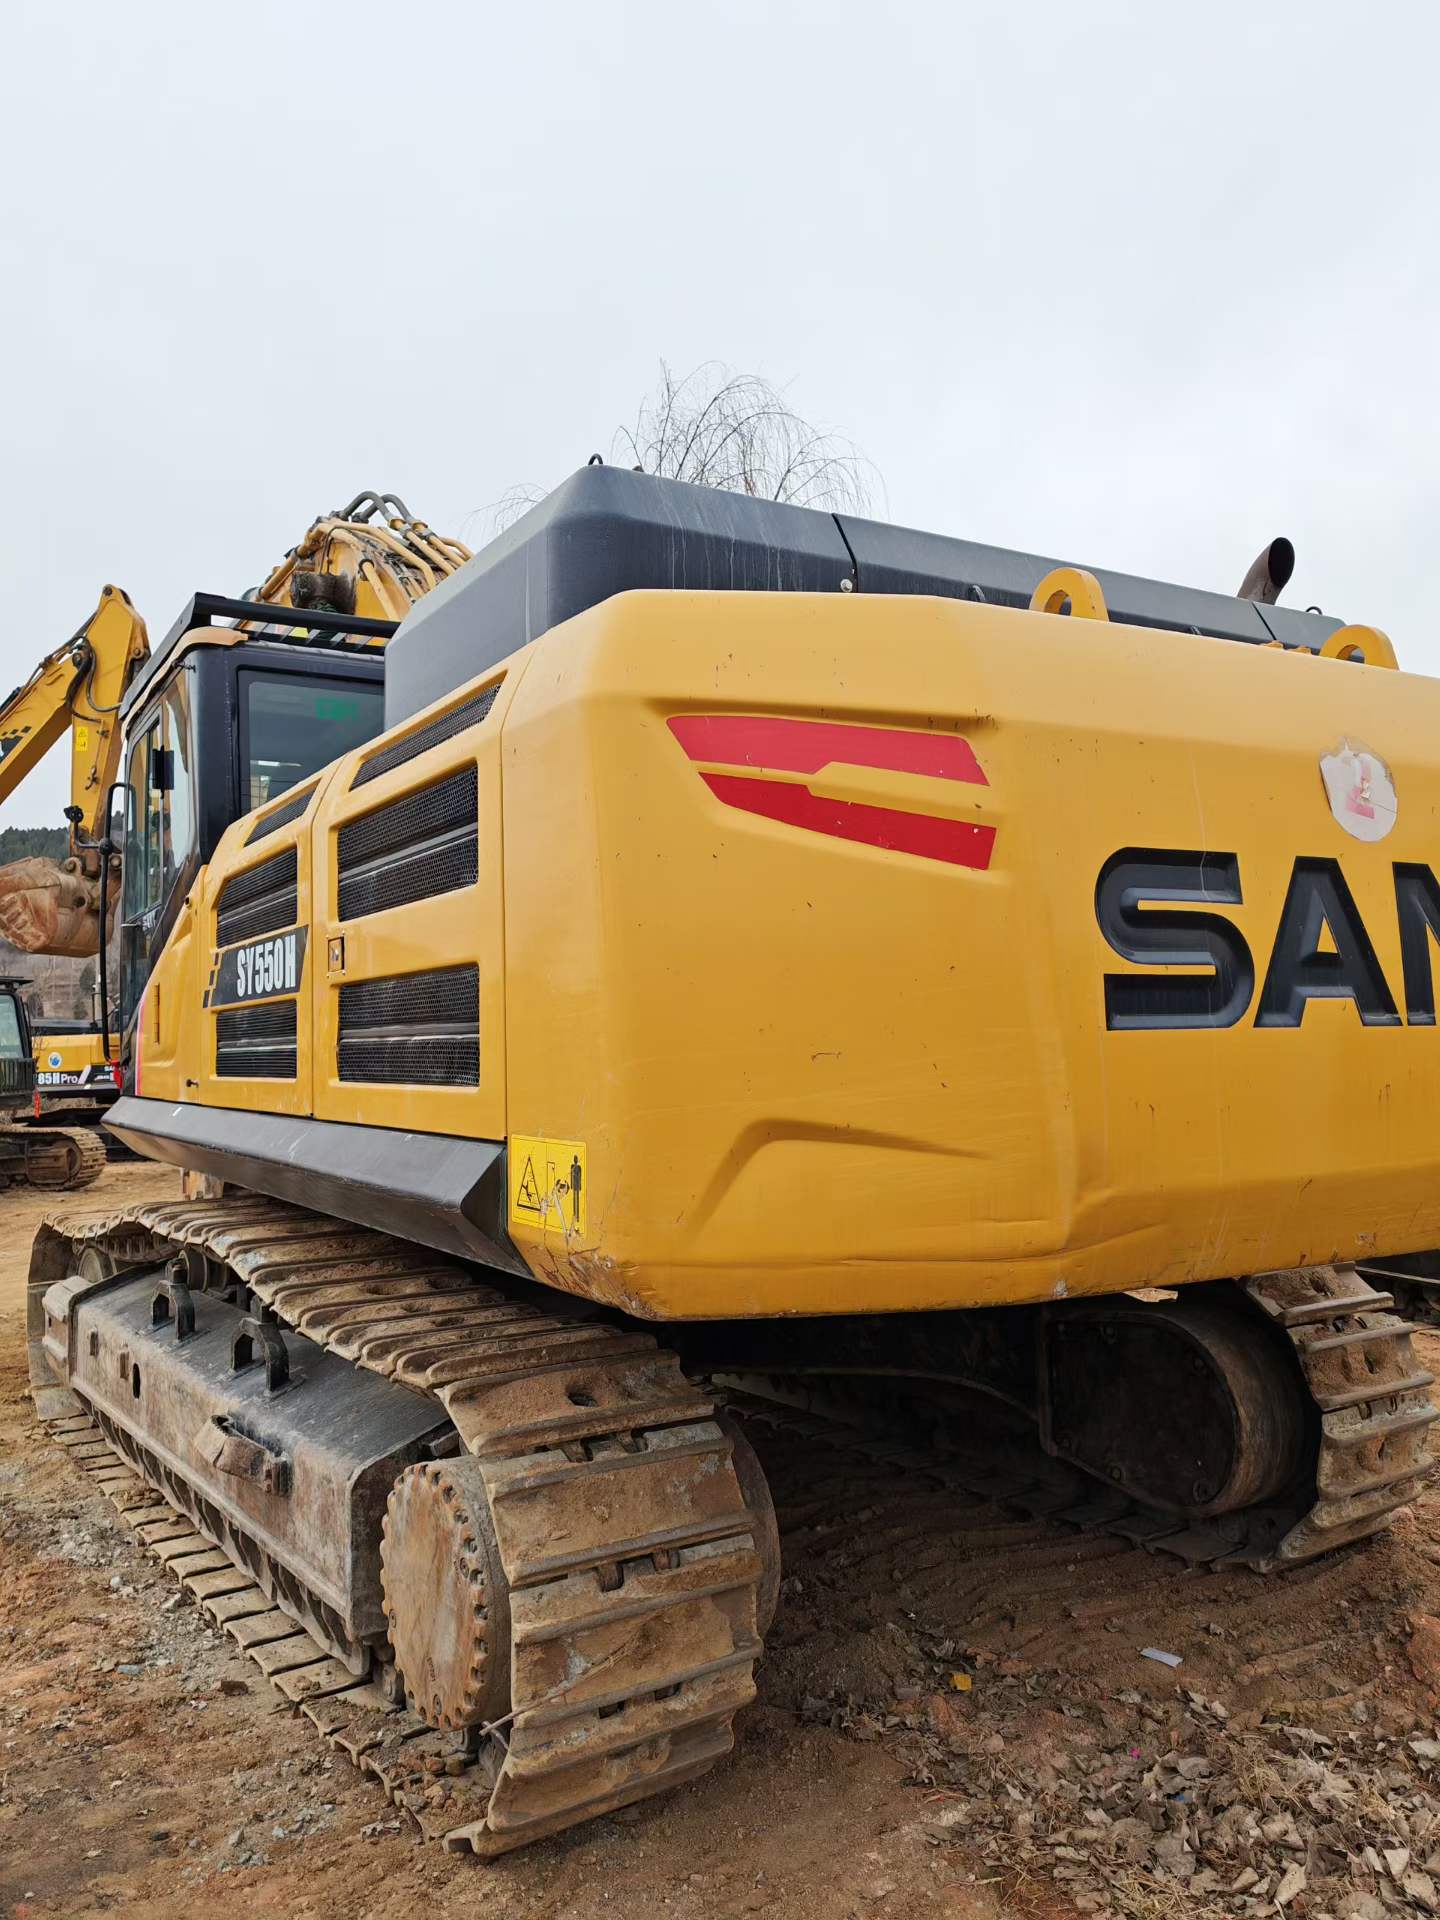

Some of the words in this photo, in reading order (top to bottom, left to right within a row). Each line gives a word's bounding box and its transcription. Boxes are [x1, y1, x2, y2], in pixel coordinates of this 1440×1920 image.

[237, 934, 296, 998] SY550H
[37, 1072, 60, 1085] 85H
[60, 1073, 78, 1084] Pro
